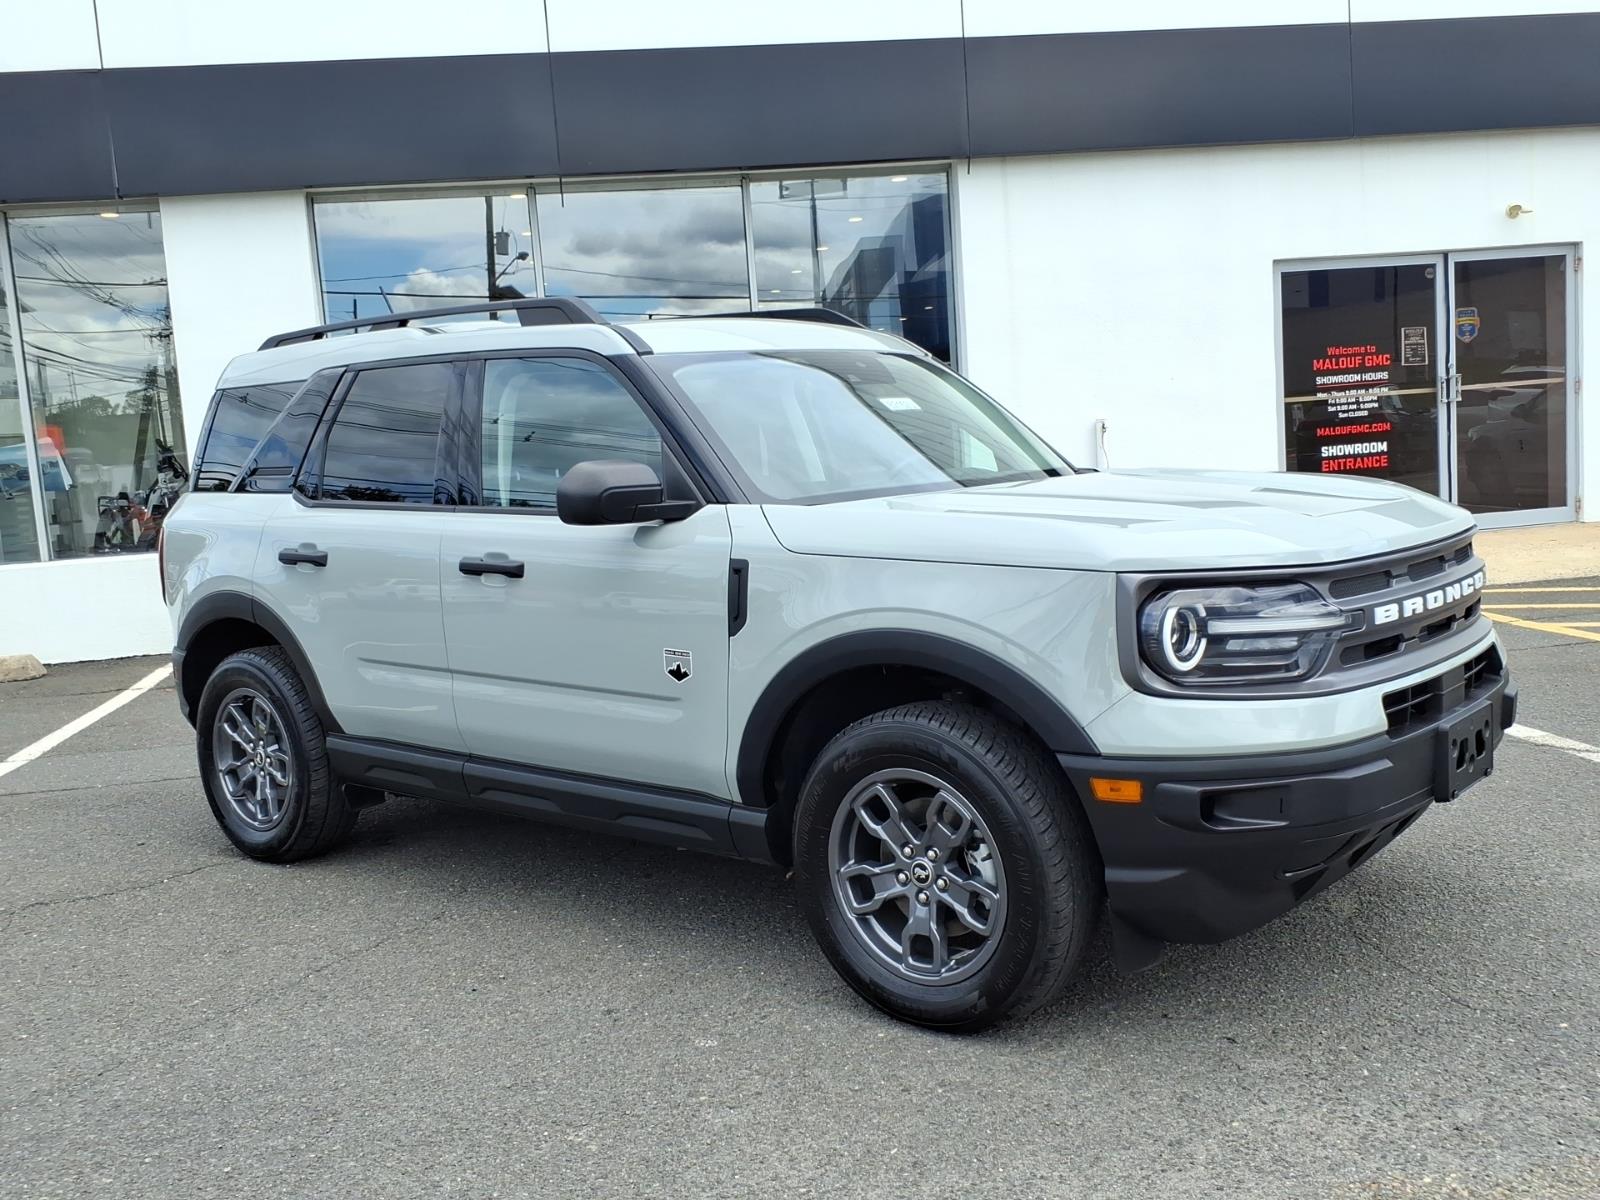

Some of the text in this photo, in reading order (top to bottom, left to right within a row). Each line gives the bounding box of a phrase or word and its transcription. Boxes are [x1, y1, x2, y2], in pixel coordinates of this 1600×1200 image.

[1327, 346, 1365, 355] Welcome
[1313, 354, 1390, 370] MALOUF GMC
[1316, 372, 1388, 384] SHOWROOM HOURS
[1317, 423, 1390, 436] MALOUFGMC.COM
[1321, 441, 1387, 457] SHOWROOM
[1322, 456, 1388, 472] ENTRANCE
[1374, 572, 1483, 624] BRONCO
